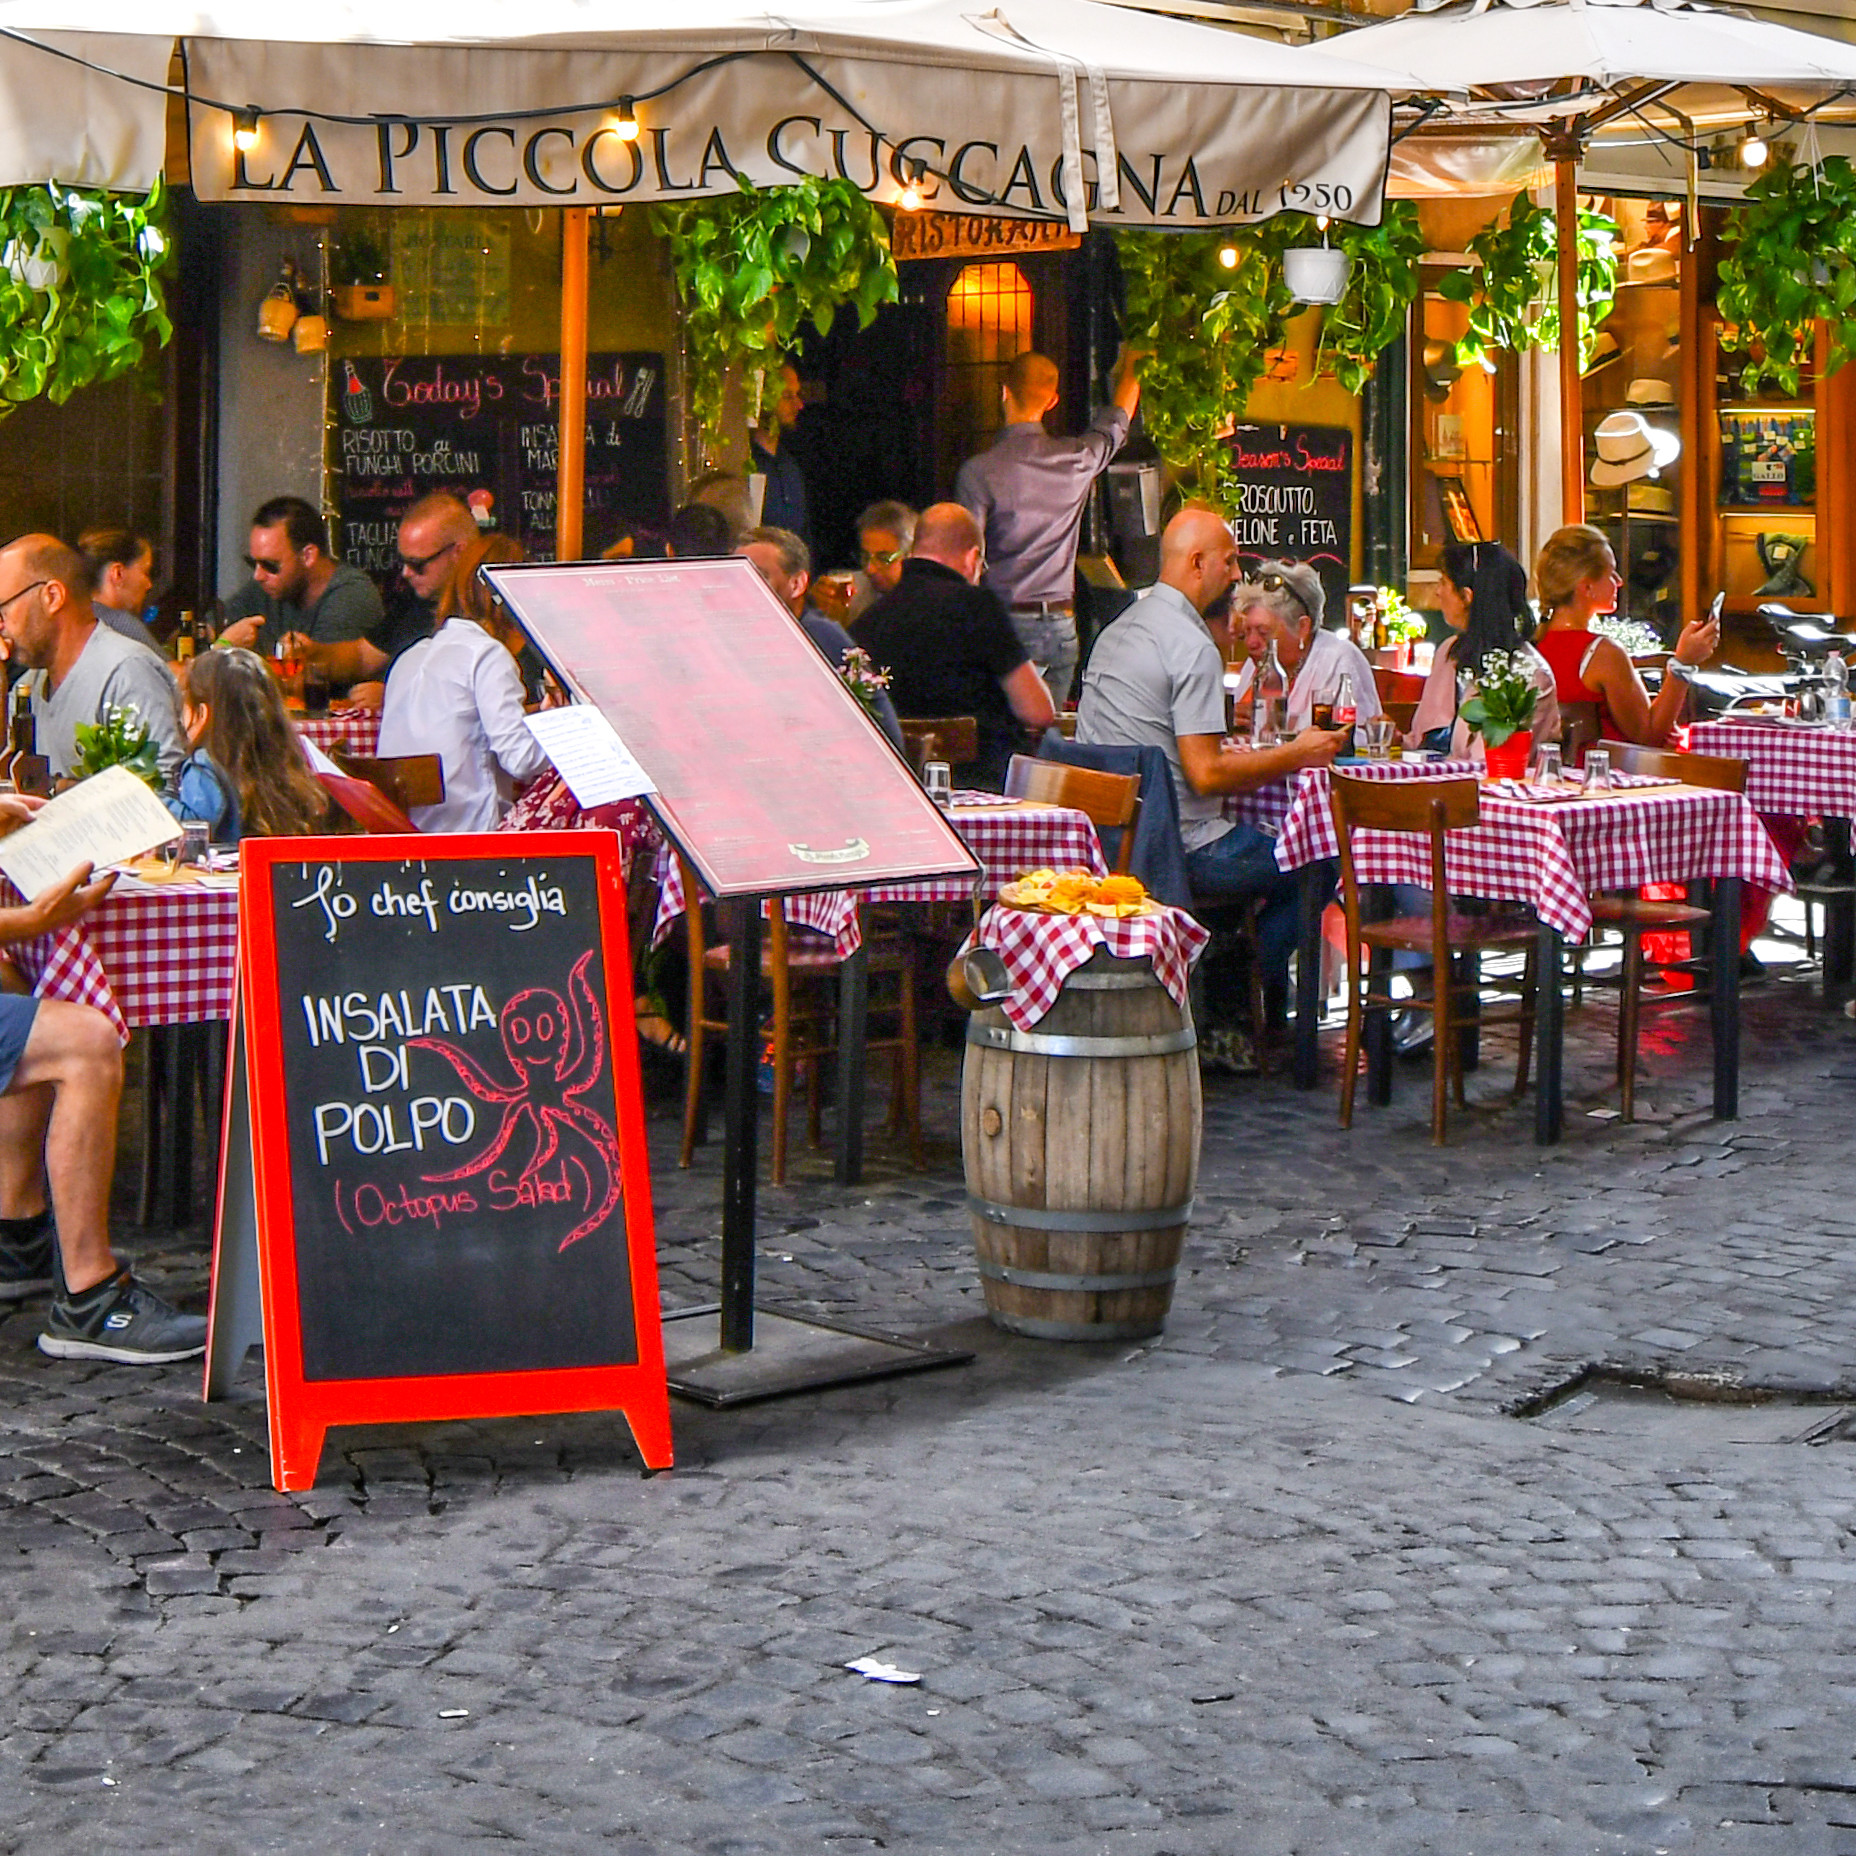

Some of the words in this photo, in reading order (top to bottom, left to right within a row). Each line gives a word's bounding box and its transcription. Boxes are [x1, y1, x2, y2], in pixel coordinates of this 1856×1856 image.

[229, 115, 342, 192] LA
[368, 113, 756, 195] PICCOLA
[766, 115, 1210, 218] CUCCAGNA
[1216, 189, 1264, 216] DAL
[382, 357, 504, 420] Today's
[522, 356, 626, 409] Spial
[343, 429, 415, 455] RISOTTO
[345, 453, 403, 476] FUNGHI
[412, 451, 481, 475] PORCINI
[1300, 519, 1338, 546] FETA
[370, 878, 440, 933] chef
[447, 871, 569, 932] consiglia
[302, 983, 497, 1046] INSALATA
[359, 1044, 410, 1093] DI
[313, 1096, 477, 1166] POLPO
